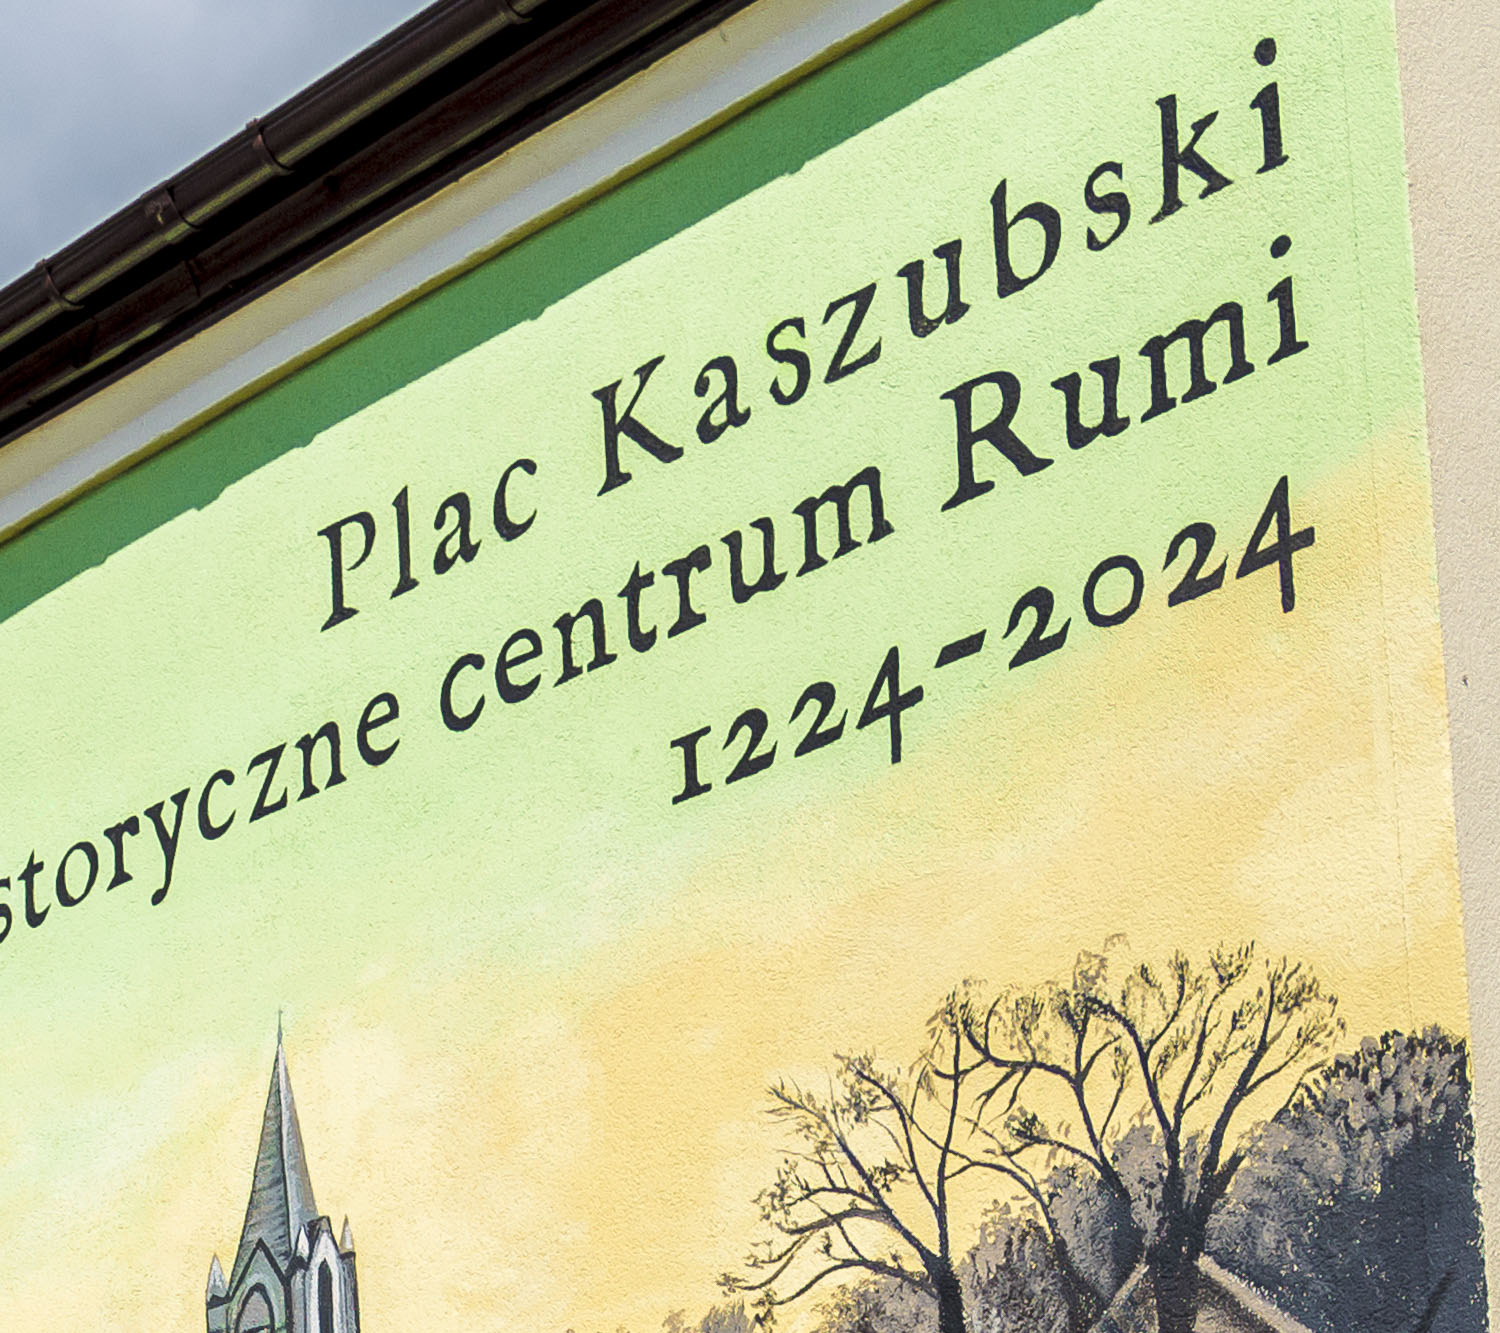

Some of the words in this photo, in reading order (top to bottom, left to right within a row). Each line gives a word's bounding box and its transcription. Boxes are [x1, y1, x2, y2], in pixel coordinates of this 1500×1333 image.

[318, 458, 537, 632] Plac
[591, 37, 1290, 497] Kaszubski
[440, 466, 895, 732] centrum
[939, 234, 1309, 513] Rumi
[670, 475, 1315, 805] 1224-2024
